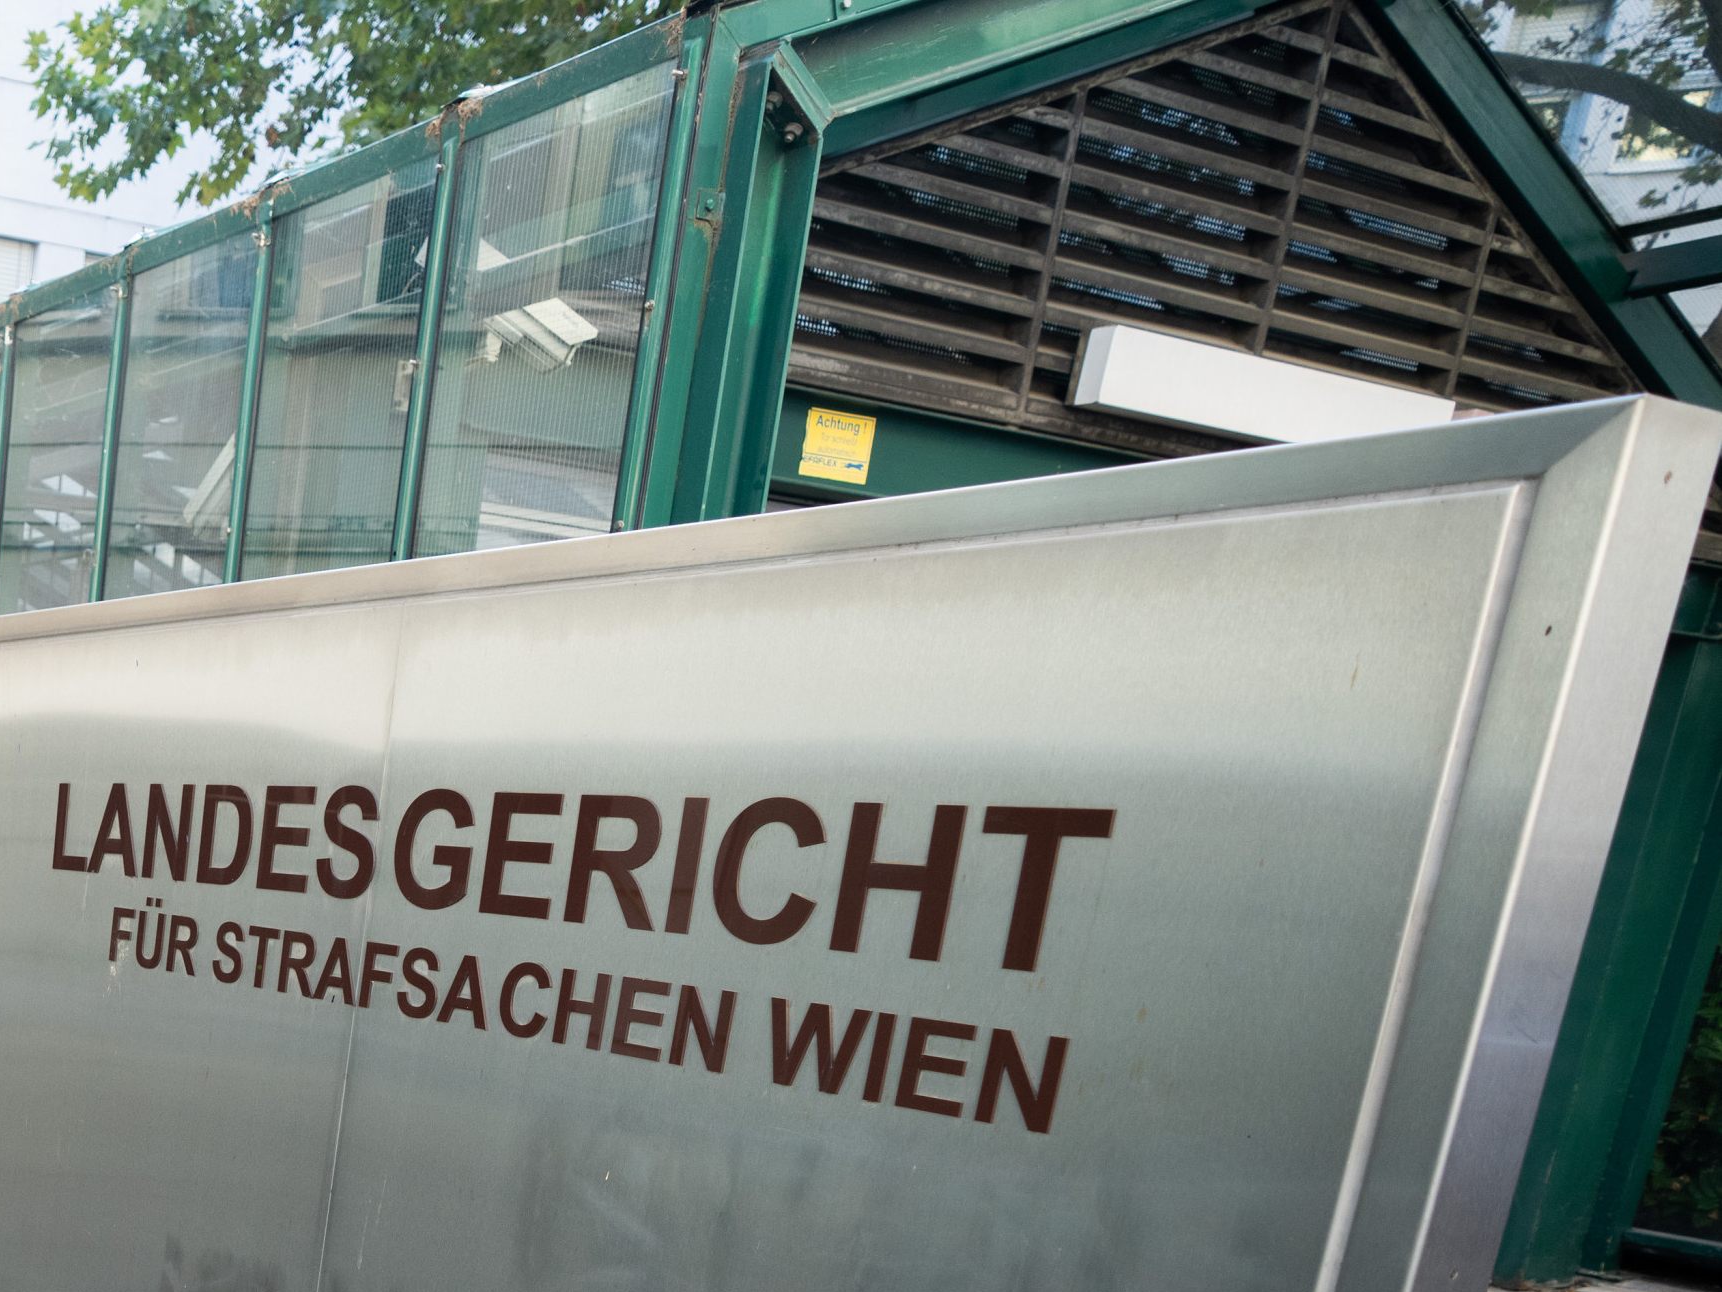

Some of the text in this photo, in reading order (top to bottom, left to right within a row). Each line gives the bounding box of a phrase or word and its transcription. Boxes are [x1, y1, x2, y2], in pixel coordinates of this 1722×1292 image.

[816, 414, 861, 436] Achtung
[52, 783, 1117, 972] LANDESGERICHT
[109, 897, 1070, 1134] FÜR STRAFSACHEN WIEN
